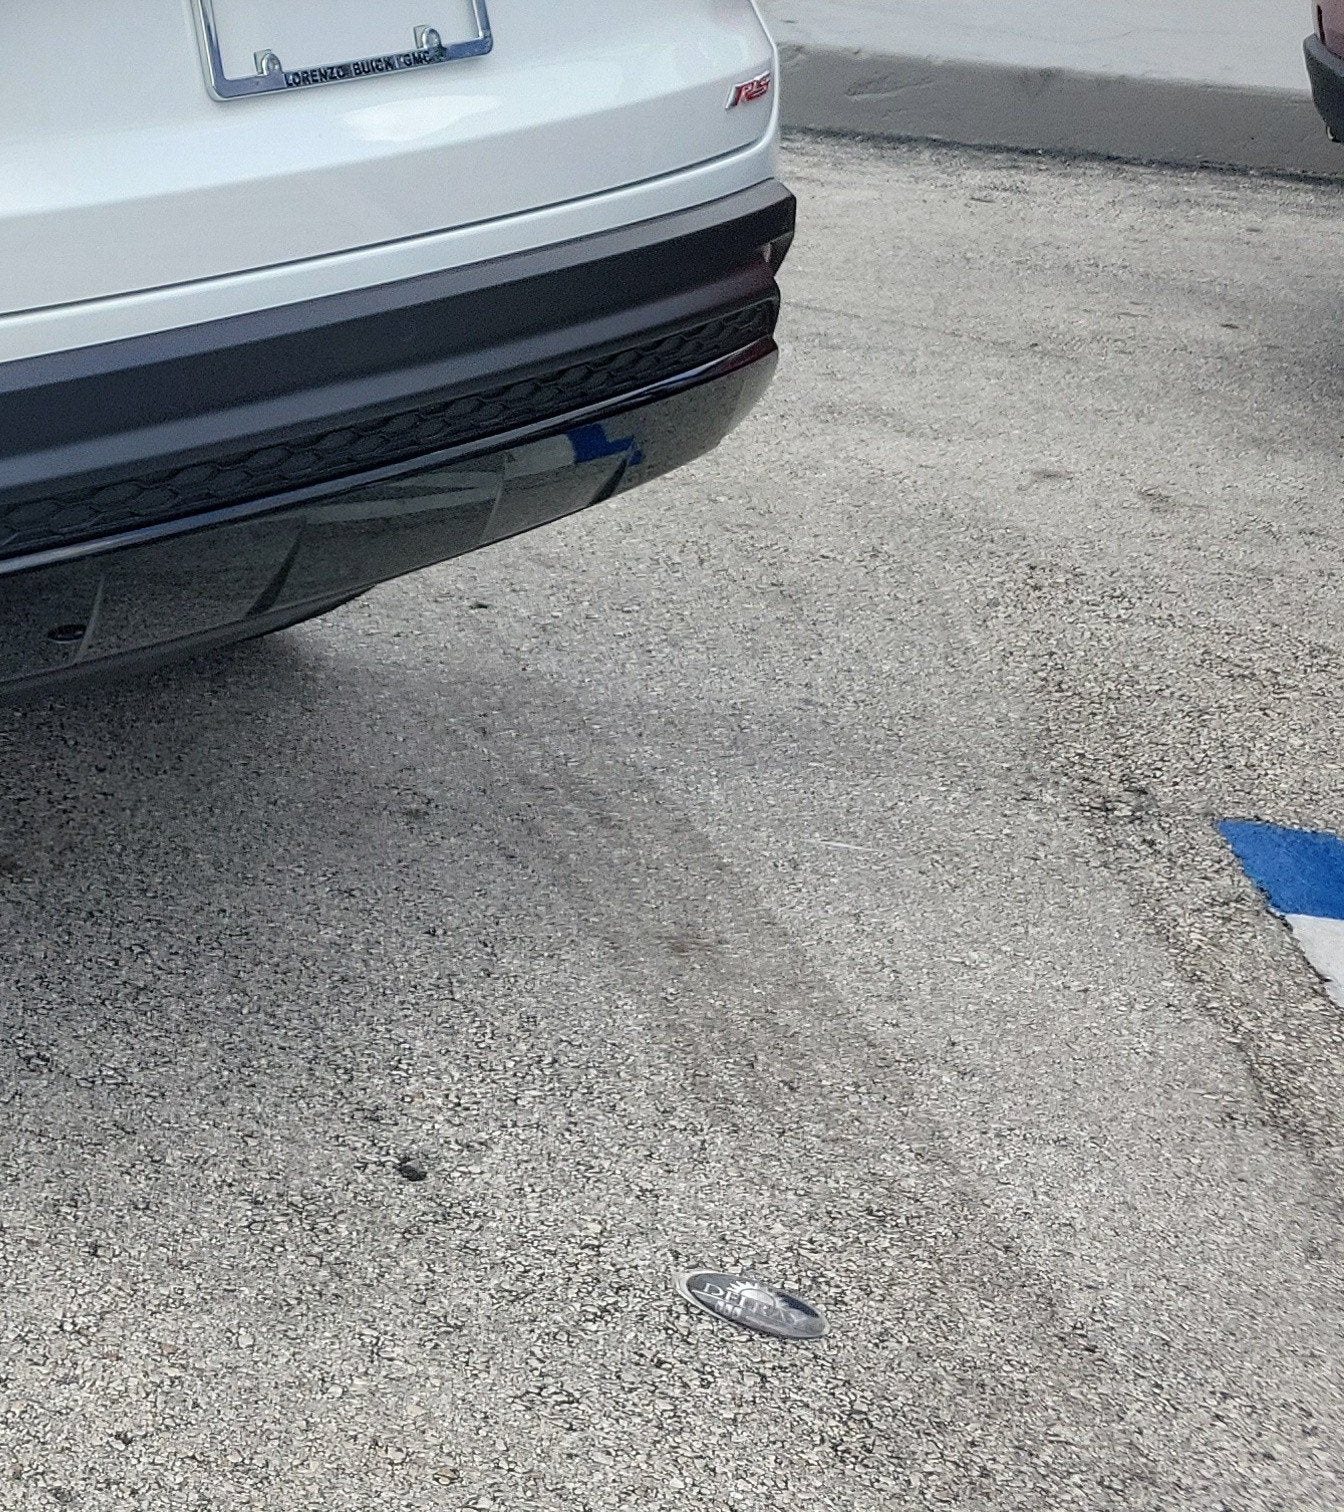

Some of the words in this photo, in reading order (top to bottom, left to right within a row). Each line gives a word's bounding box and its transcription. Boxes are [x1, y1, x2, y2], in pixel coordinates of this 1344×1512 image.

[284, 65, 347, 88] LORENZO
[353, 57, 394, 76] BUICK
[725, 70, 771, 110] RS
